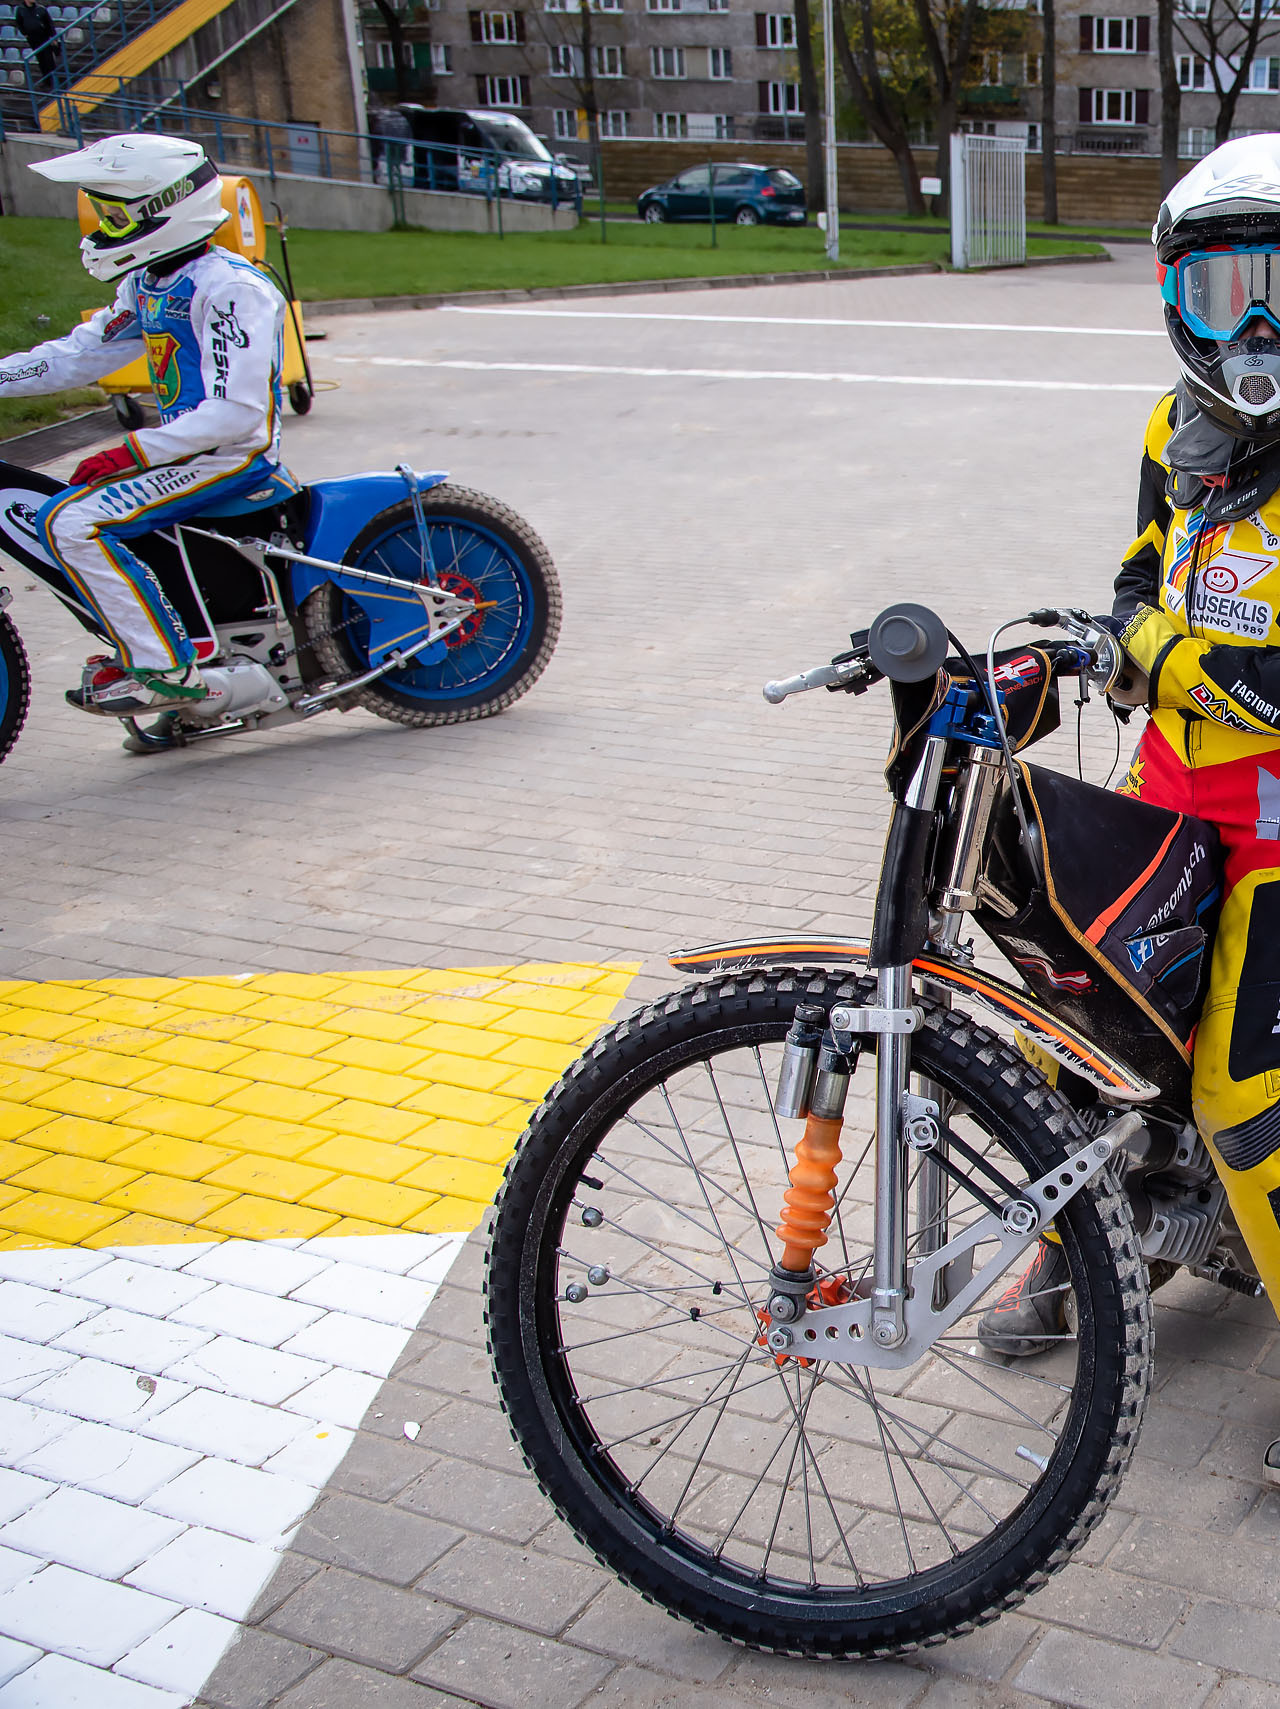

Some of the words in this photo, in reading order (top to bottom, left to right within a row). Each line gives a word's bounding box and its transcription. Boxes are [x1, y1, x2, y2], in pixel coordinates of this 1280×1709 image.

[137, 176, 195, 219] 100%
[211, 320, 229, 399] VESKE
[146, 468, 180, 486] tec
[1191, 613, 1231, 628] ANNO
[1237, 622, 1264, 636] 1989
[1195, 594, 1268, 625] USEKLIS
[1229, 680, 1280, 724] FACTORY
[1146, 842, 1206, 946] @teambch
